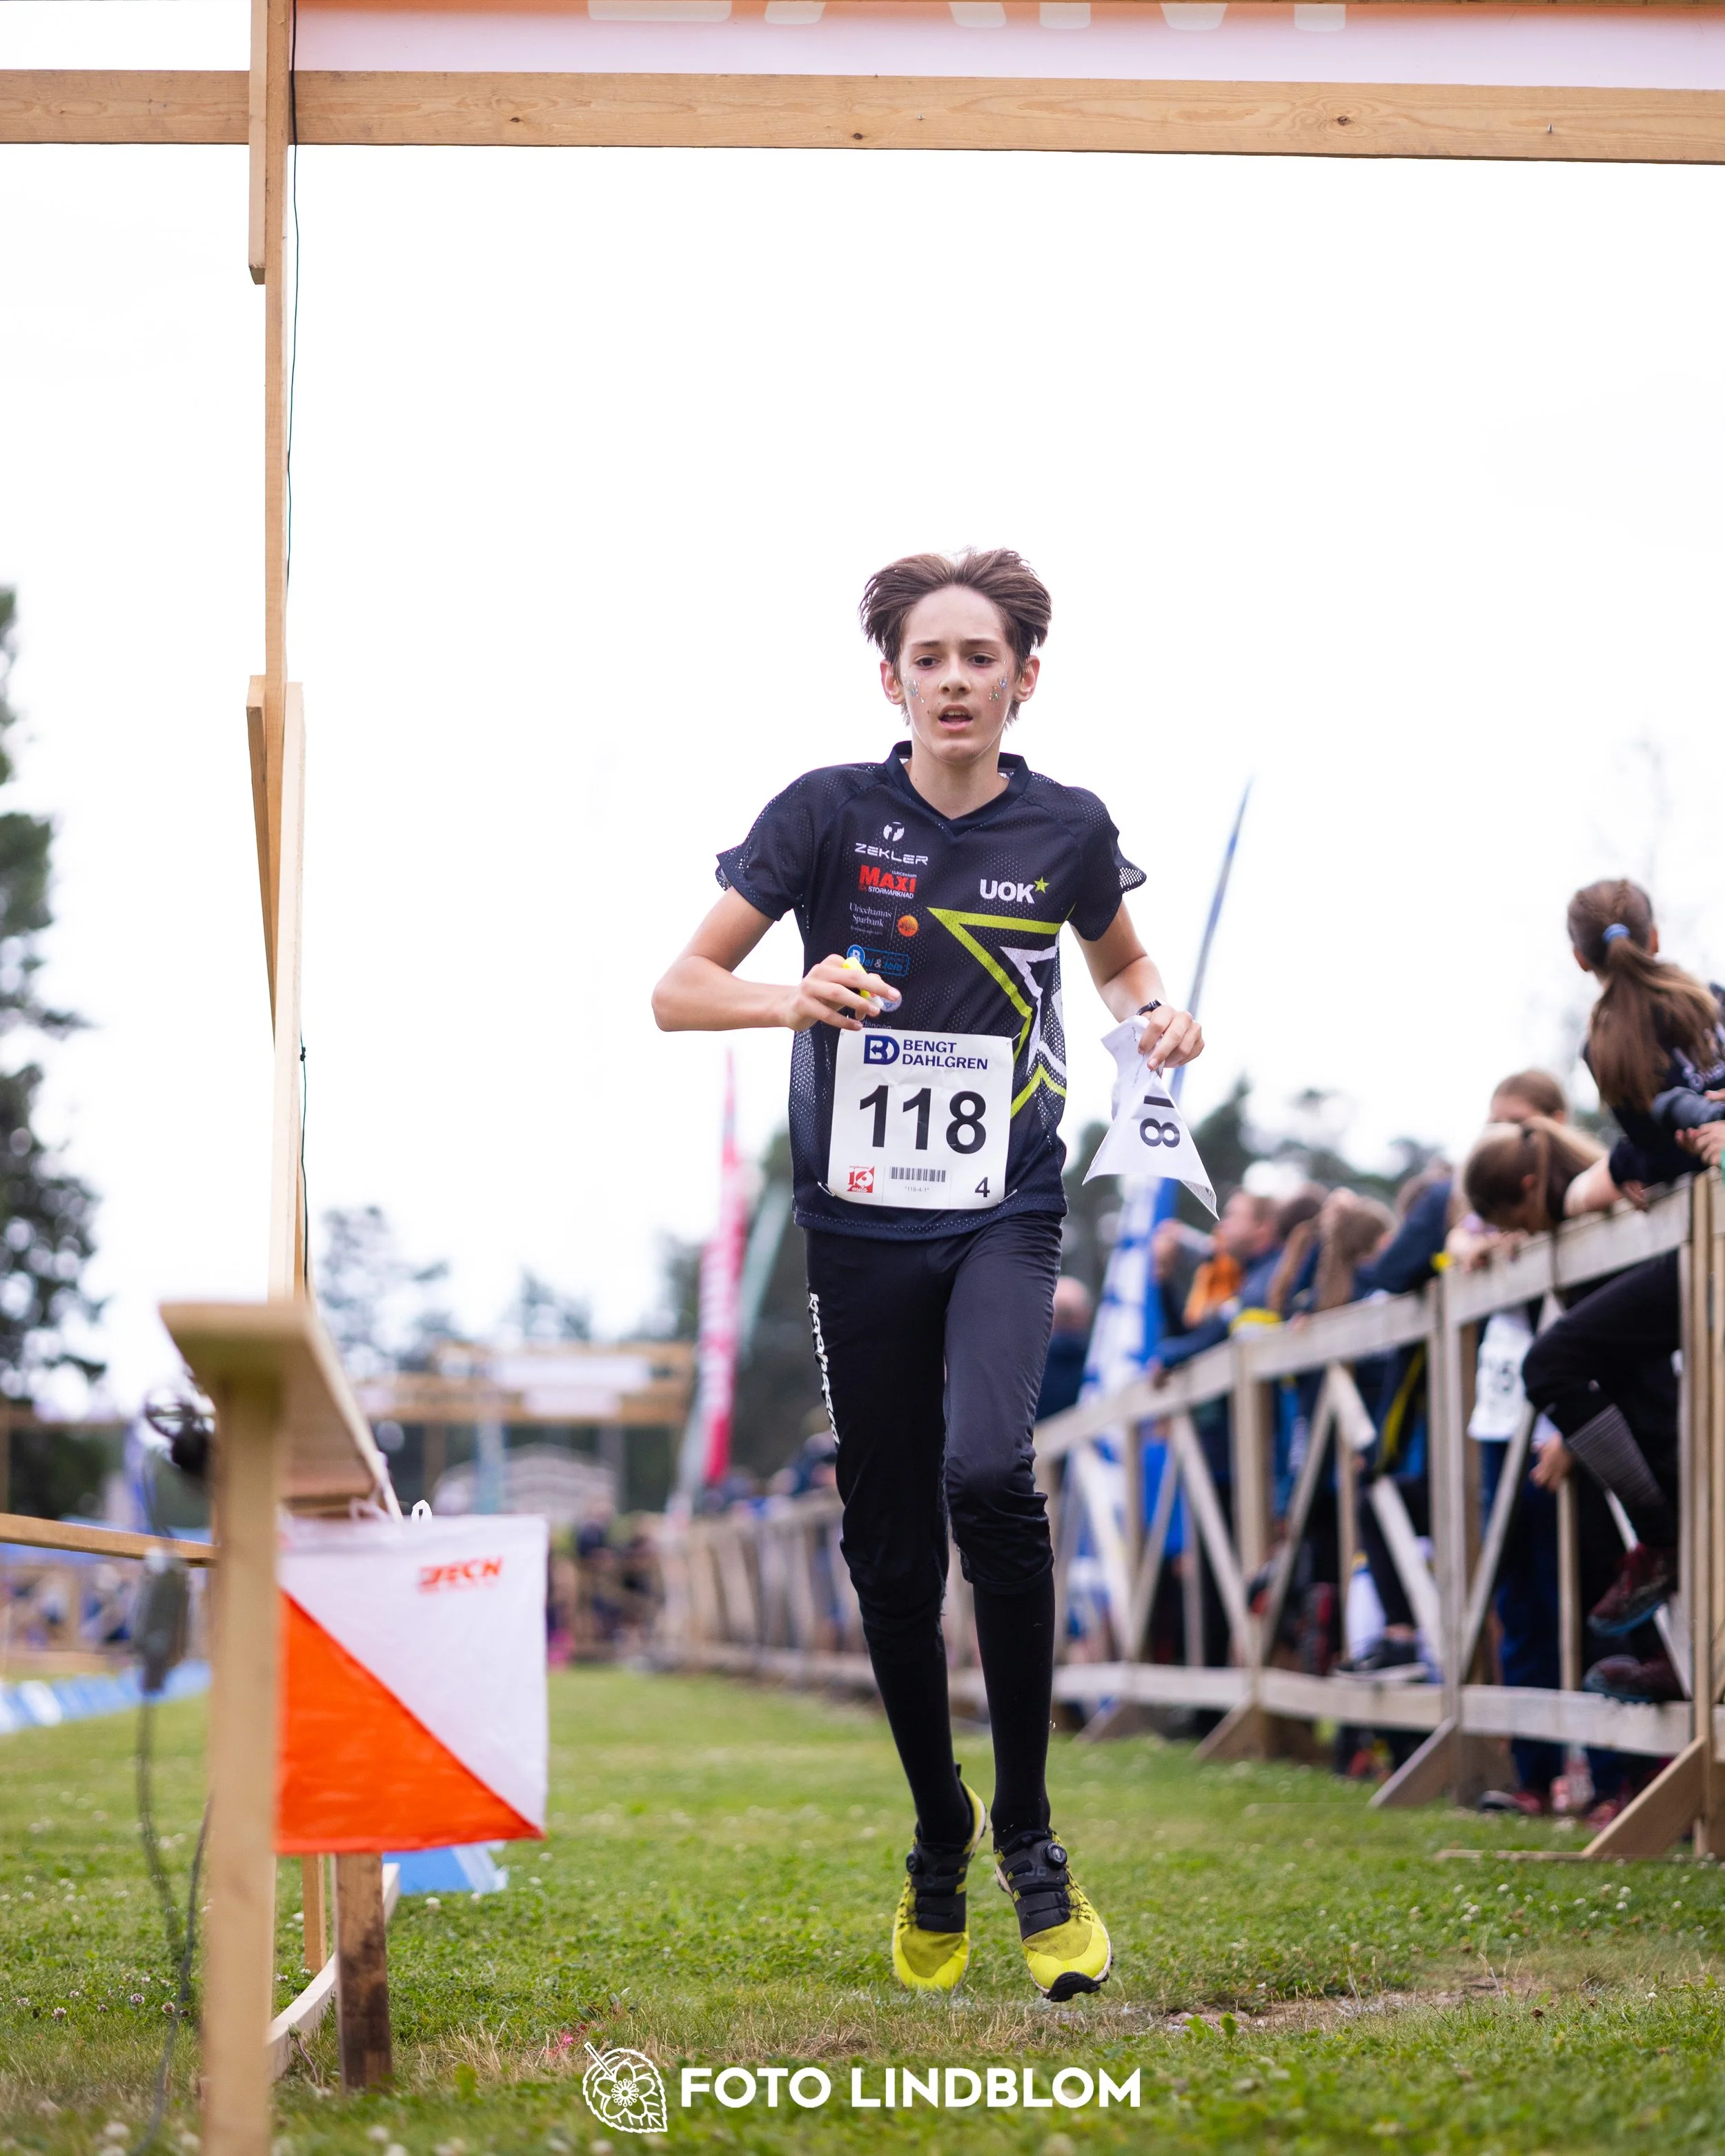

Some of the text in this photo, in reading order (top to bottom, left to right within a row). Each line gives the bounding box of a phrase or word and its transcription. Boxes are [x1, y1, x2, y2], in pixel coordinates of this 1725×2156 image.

[855, 842, 929, 866] ZEKLER
[859, 864, 916, 893] MAXI
[868, 886, 914, 899] STORMARKNAD
[980, 878, 1035, 904] UOK
[849, 902, 892, 918] Ulricehamns
[853, 913, 883, 927] Sparbank
[903, 1039, 957, 1054] BENGT
[903, 1054, 988, 1070] DAHLGREN
[859, 1085, 987, 1155] 118
[974, 1176, 991, 1198] 4
